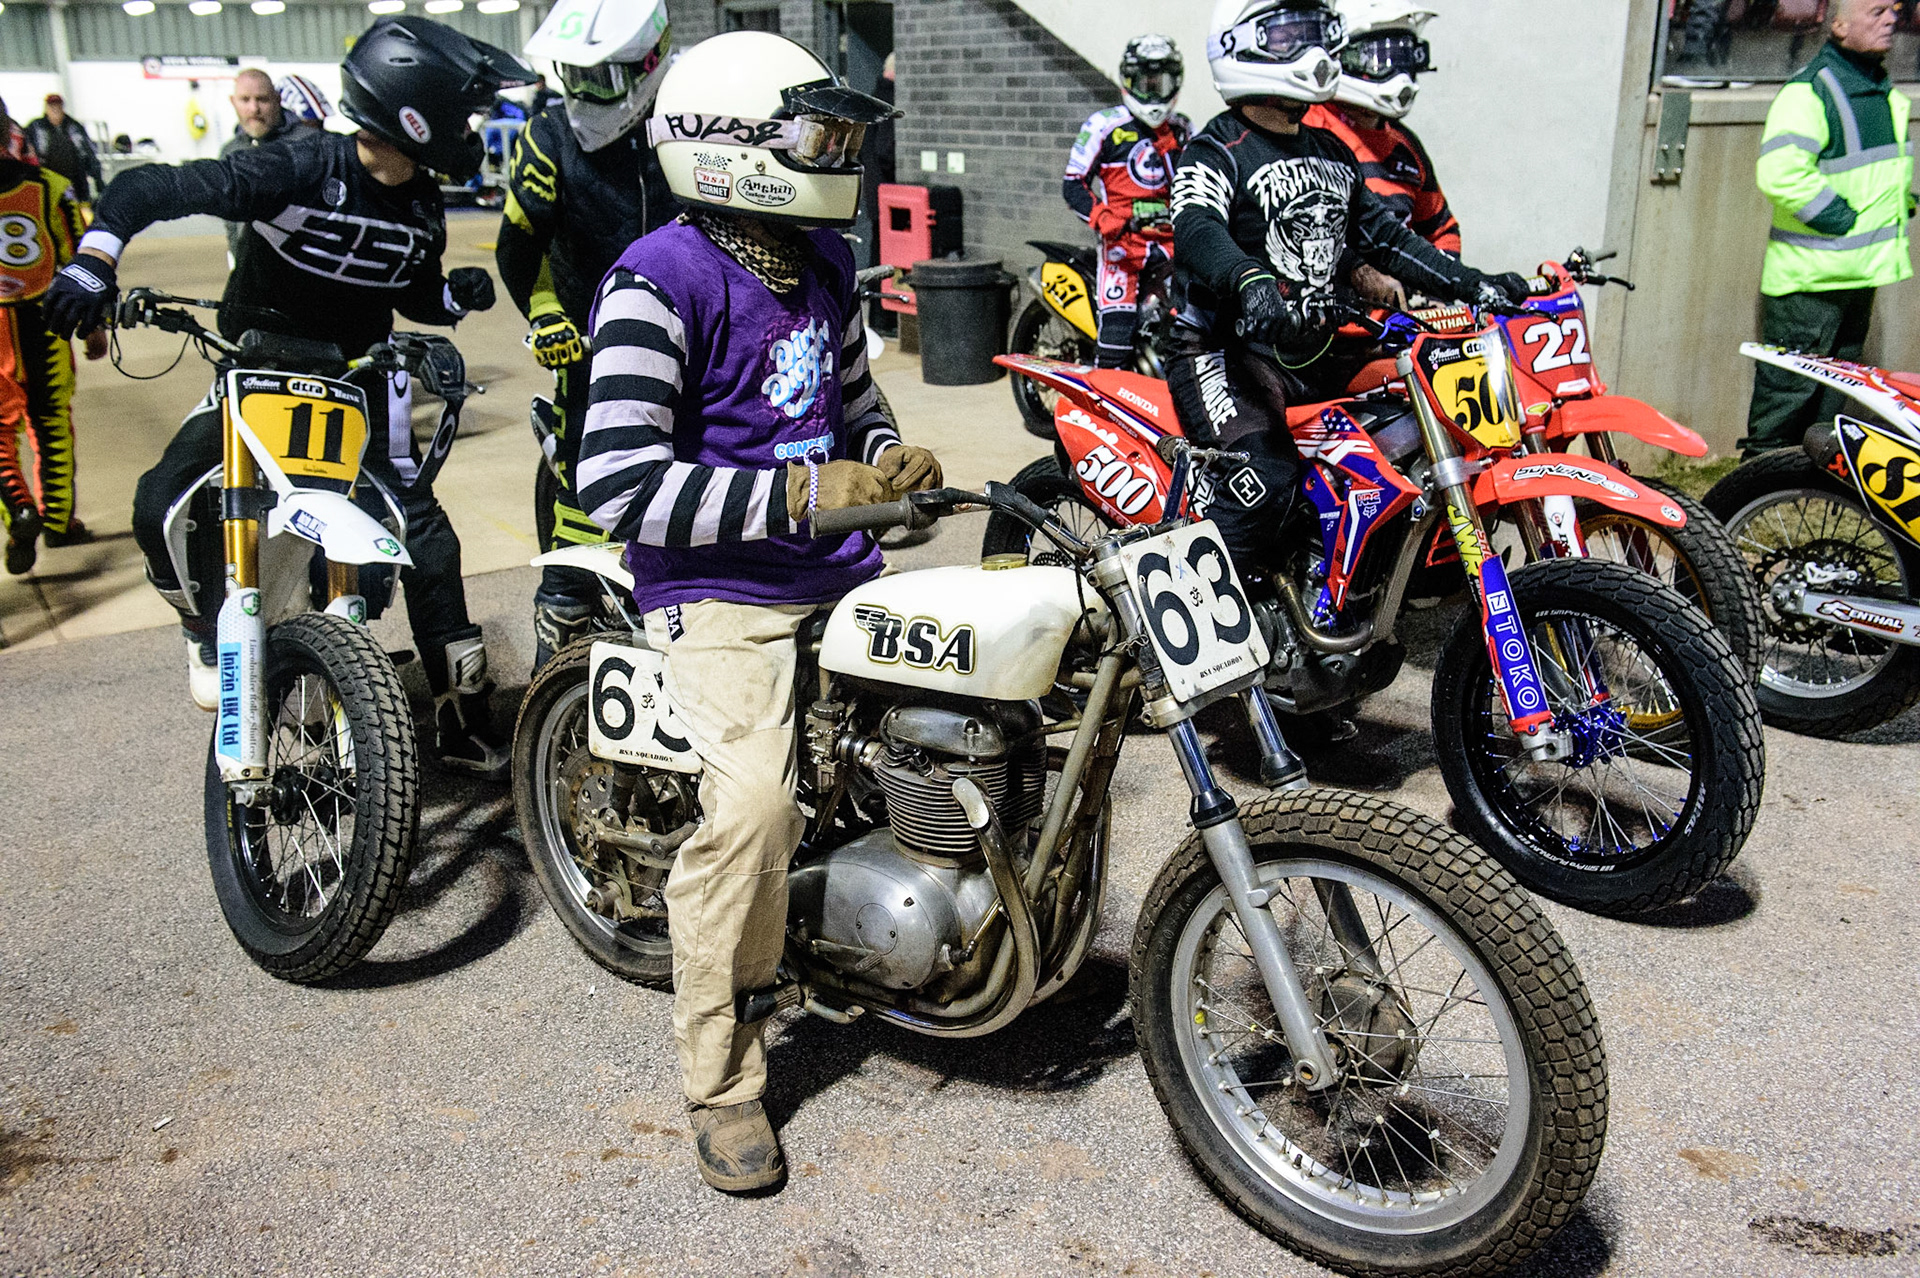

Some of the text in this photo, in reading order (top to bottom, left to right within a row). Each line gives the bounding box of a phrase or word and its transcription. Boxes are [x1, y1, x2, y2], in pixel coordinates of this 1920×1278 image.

[405, 112, 426, 139] BELL
[699, 183, 729, 198] HORNET
[702, 174, 726, 185] BSA
[741, 178, 793, 196] Anthill
[1428, 347, 1460, 362] Indian
[1523, 317, 1592, 374] 22
[242, 376, 281, 387] Indian
[292, 381, 324, 394] dtra
[1800, 362, 1865, 388] DUNLOP
[1117, 387, 1159, 418] HONDA
[279, 402, 346, 465] 11
[1076, 445, 1155, 515] 500
[1137, 536, 1251, 666] 63
[868, 613, 972, 672] BSA
[1213, 656, 1243, 674] SQUADRON
[221, 651, 239, 746] Inizio UK Ltd
[619, 748, 674, 763] BSA SQUADRON
